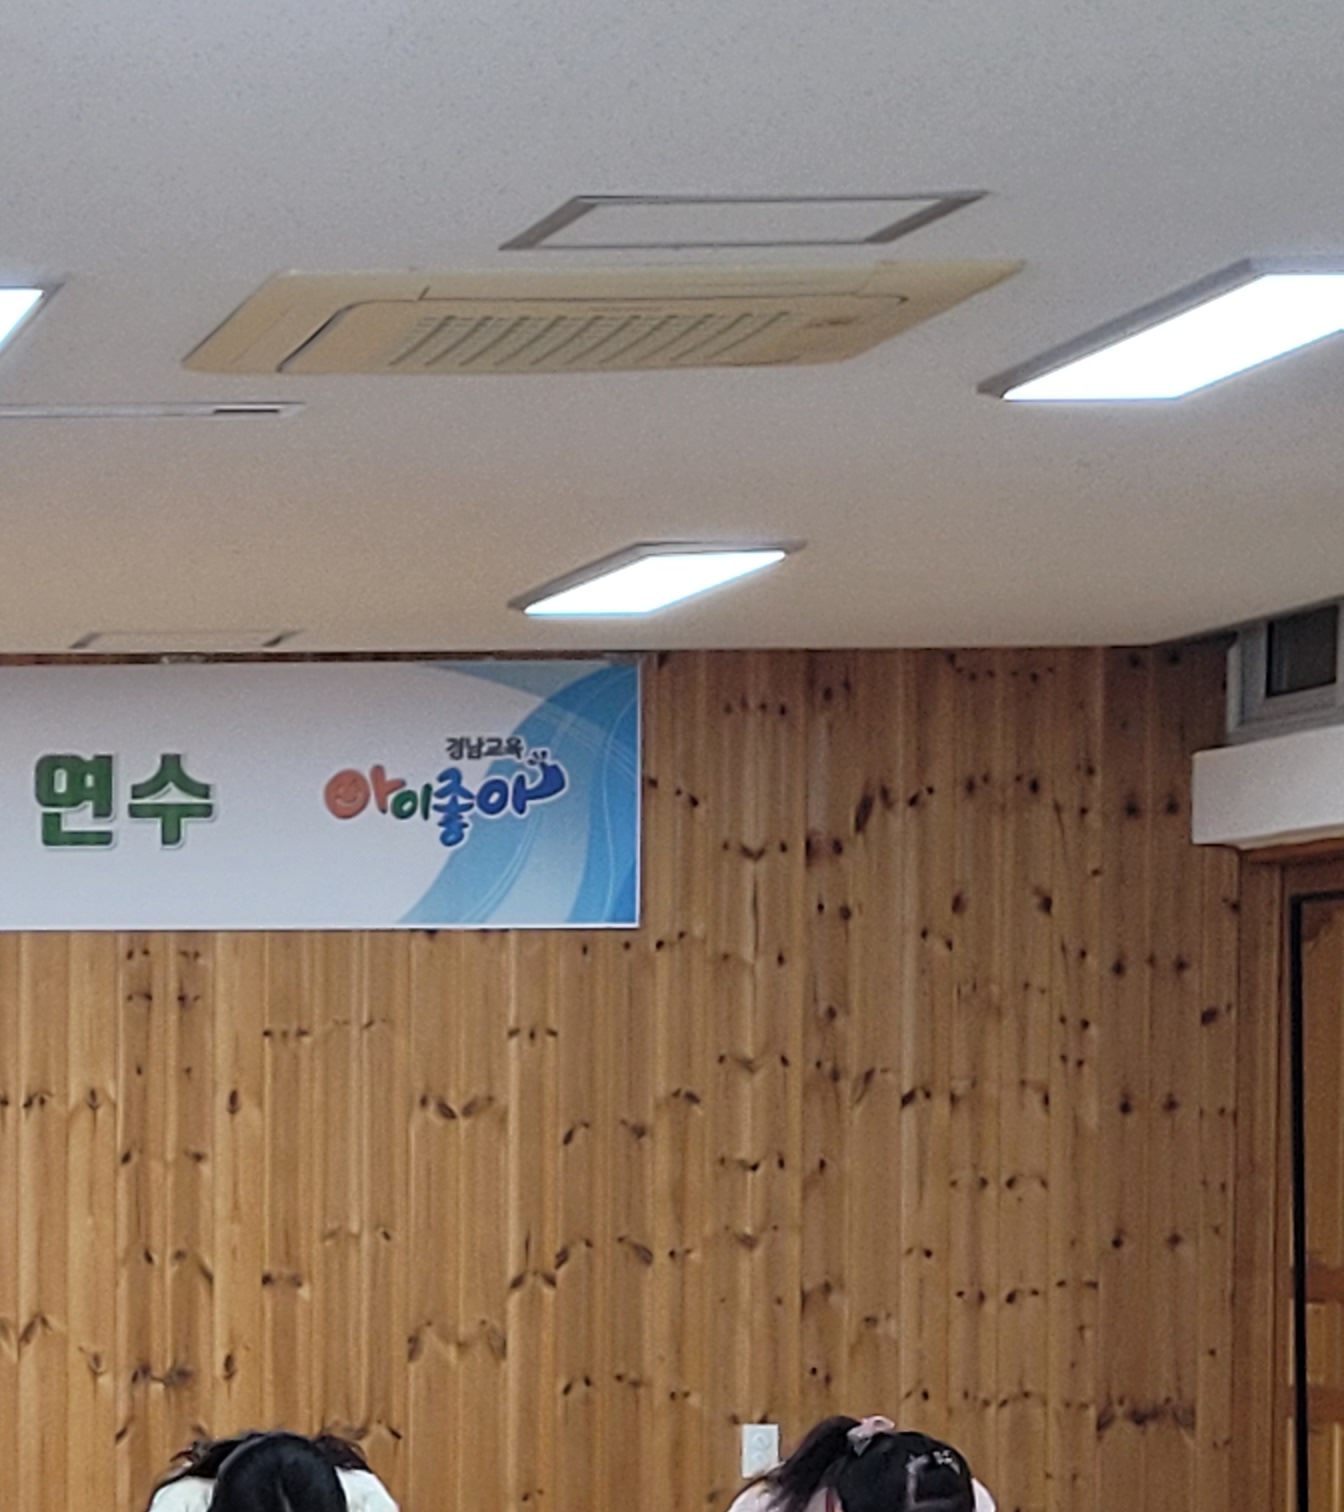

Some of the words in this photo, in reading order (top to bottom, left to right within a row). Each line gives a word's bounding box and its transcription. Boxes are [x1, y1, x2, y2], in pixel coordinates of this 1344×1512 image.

[446, 736, 524, 760] 경남교육
[34, 753, 214, 847] 연수
[324, 764, 566, 847] 아이좋아
